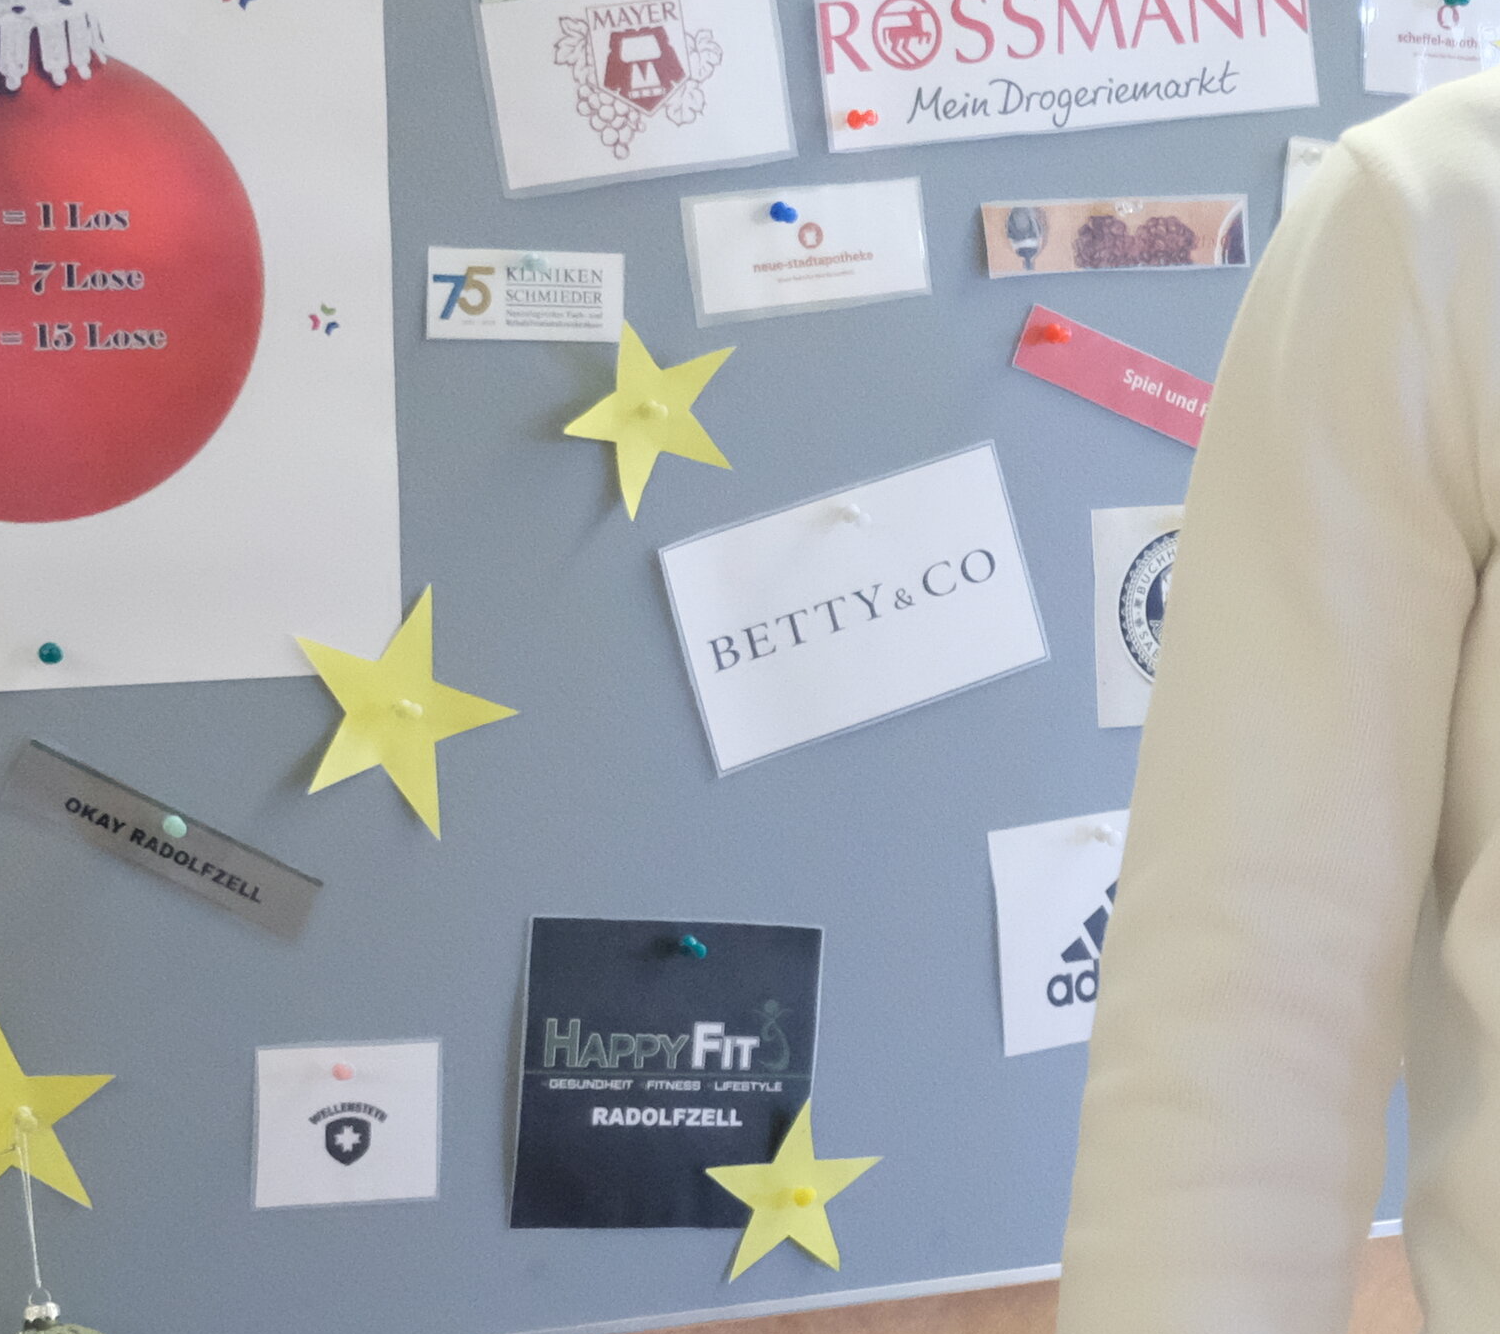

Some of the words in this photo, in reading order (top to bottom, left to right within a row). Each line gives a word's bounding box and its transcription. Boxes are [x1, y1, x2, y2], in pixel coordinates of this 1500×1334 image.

[591, 1, 679, 30] MAYER
[906, 86, 990, 125] Mein
[989, 60, 1241, 128] Drogeriemarkt
[3, 209, 27, 225] =
[37, 201, 56, 232] 1
[64, 200, 130, 232] Los
[30, 260, 56, 295] 7
[60, 261, 145, 292] Lose
[505, 266, 604, 284] KLINIKEN
[432, 266, 496, 320] 75
[505, 289, 604, 305] SCHMIEDER
[0, 331, 23, 347] =
[33, 323, 75, 352] 15
[83, 321, 168, 351] Lose
[1122, 368, 1163, 398] Spiel
[1165, 388, 1199, 414] und
[64, 797, 126, 835] OKAY
[129, 827, 262, 905] RADOLFZELL
[646, 1079, 702, 1092] FITNESS
[713, 1080, 783, 1093] LIFESTYLE
[591, 1106, 744, 1128] RADOLFZELL
